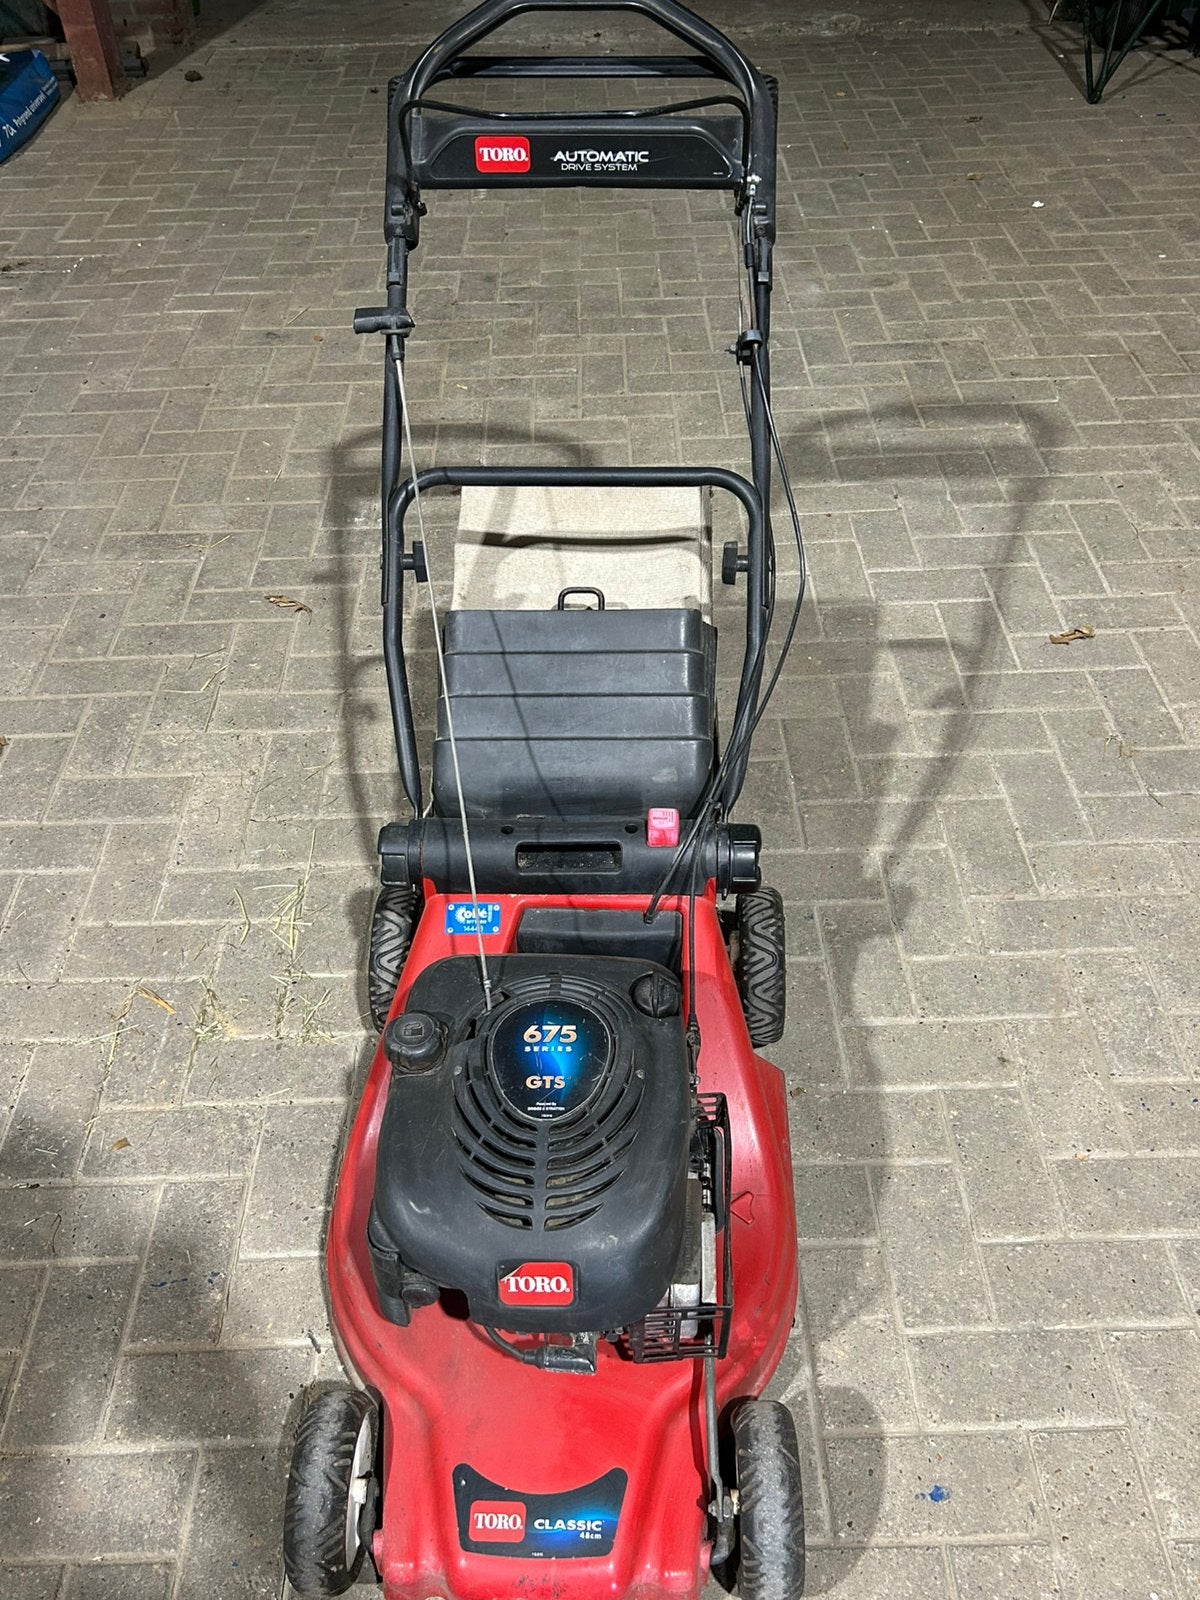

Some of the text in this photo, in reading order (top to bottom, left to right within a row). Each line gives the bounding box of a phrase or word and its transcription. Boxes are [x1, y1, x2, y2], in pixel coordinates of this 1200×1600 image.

[553, 150, 649, 163] AUTOMATIC
[561, 163, 638, 171] DRIVE SYSTEM
[523, 1025, 578, 1044] 675
[525, 1075, 566, 1089] GTS
[533, 1518, 602, 1531] CLASSIC
[579, 1531, 602, 1540] 48cm
